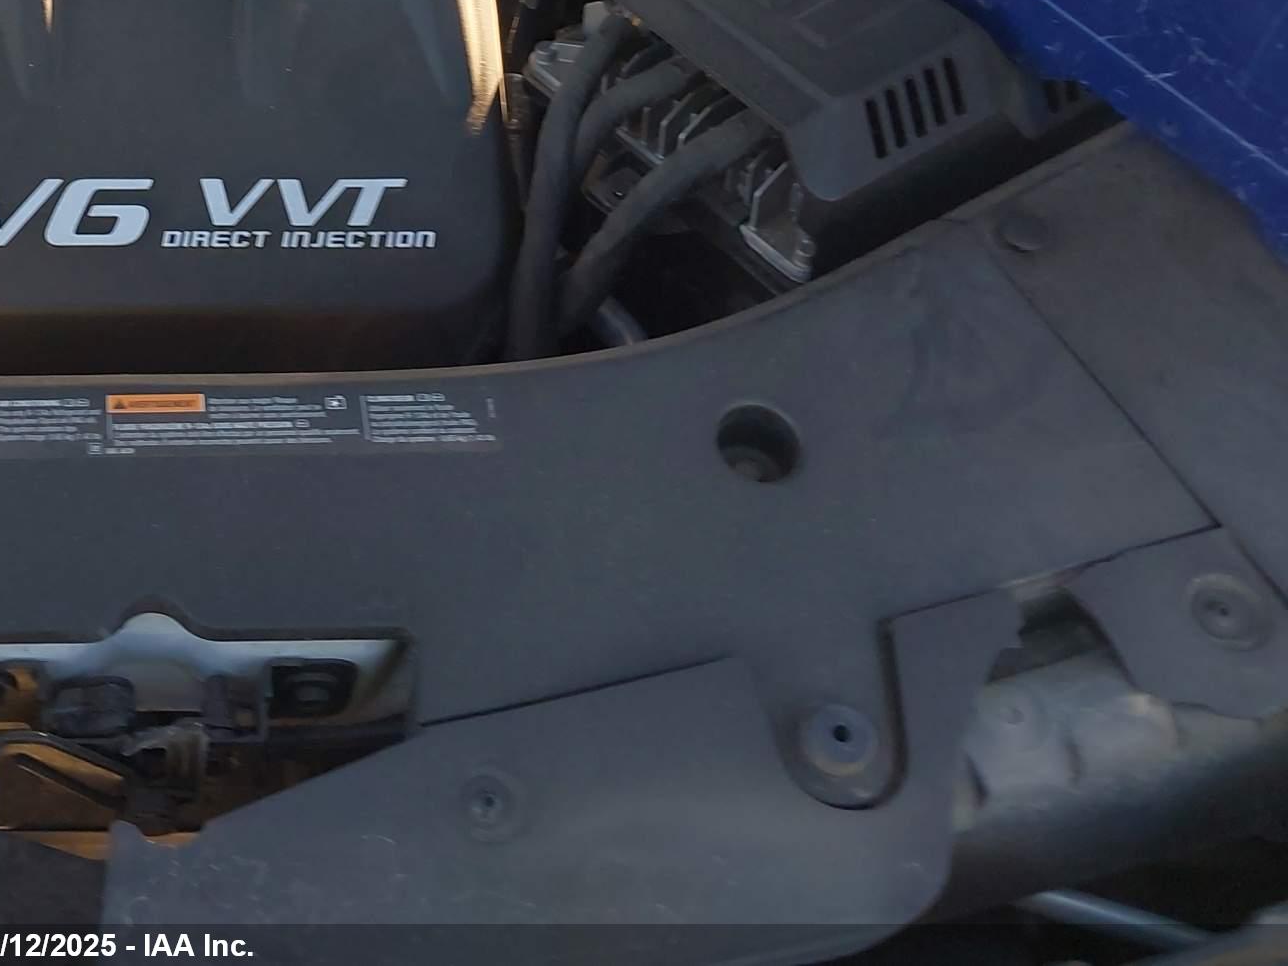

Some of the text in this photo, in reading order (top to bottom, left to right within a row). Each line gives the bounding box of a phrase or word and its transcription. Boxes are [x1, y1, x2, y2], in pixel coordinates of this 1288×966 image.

[199, 178, 408, 227] VVT
[161, 231, 436, 248] DIRECT INJECTION
